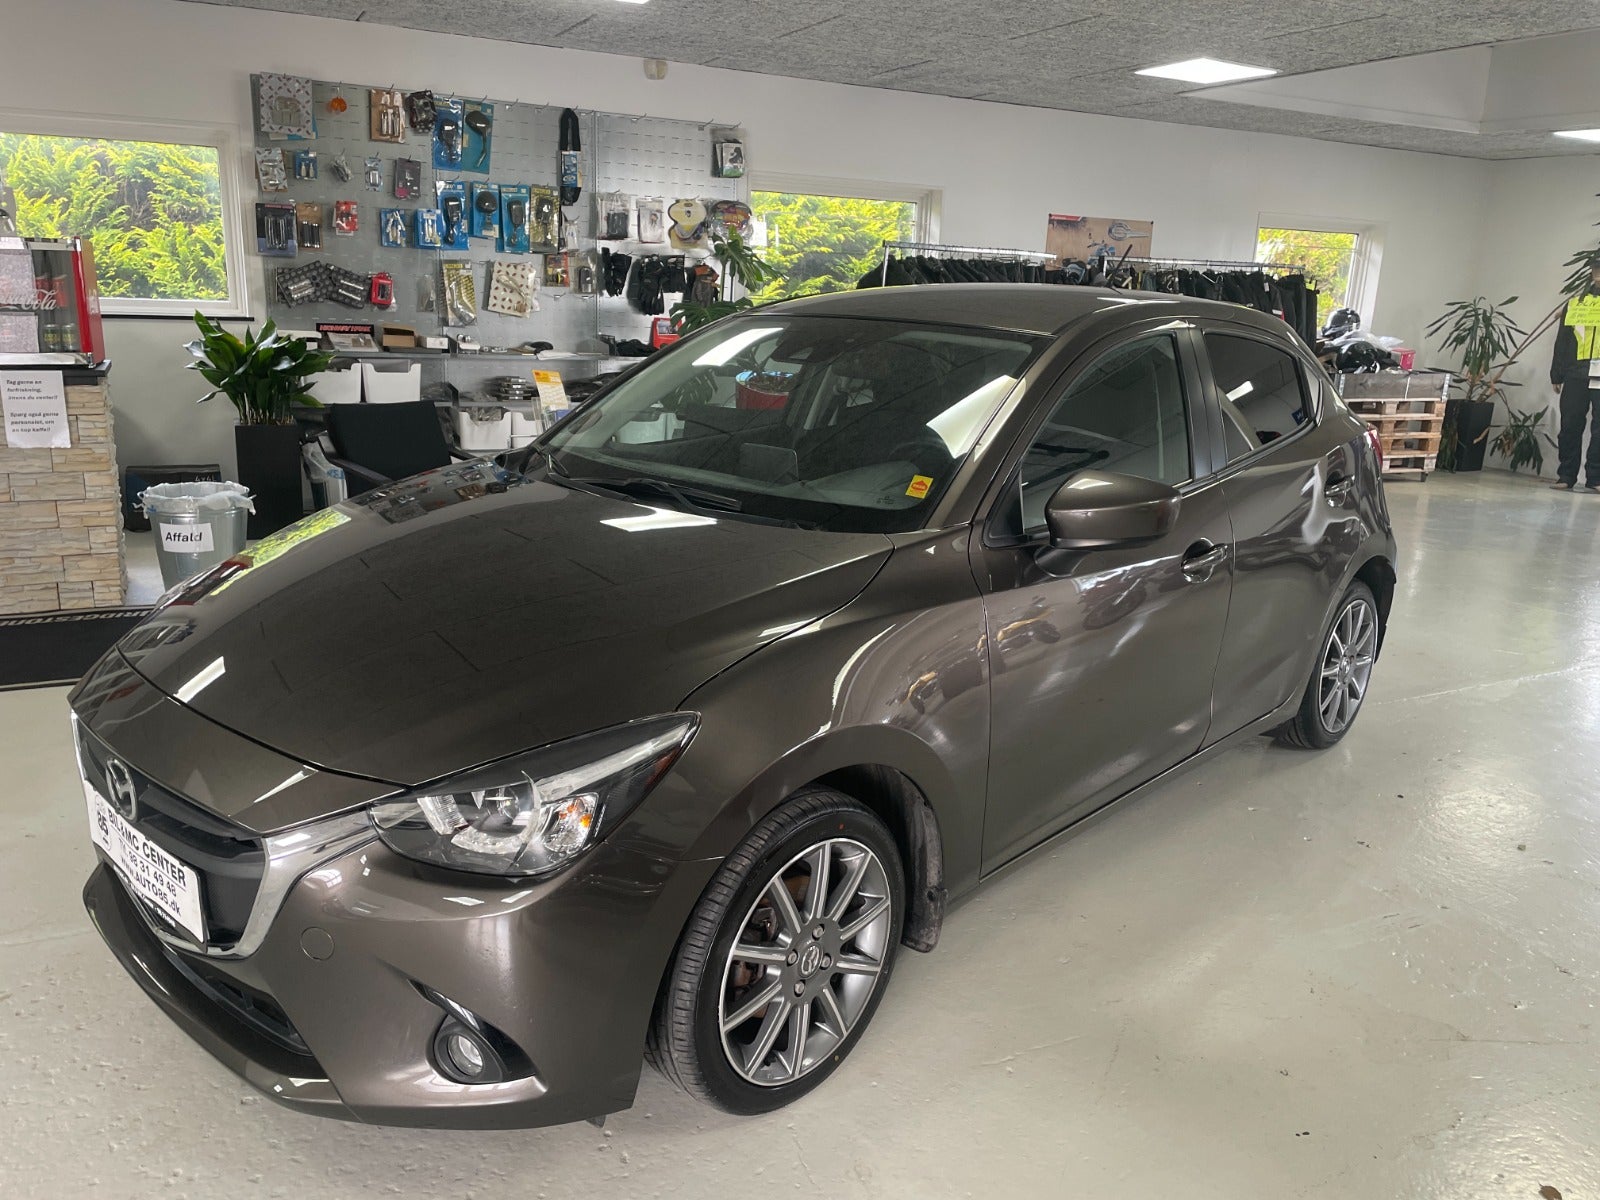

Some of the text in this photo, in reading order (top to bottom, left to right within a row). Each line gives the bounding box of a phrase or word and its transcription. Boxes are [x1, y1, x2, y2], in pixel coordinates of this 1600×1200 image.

[166, 532, 202, 542] Affald
[0, 610, 150, 626] RIDGESTON
[139, 860, 150, 877] 31
[153, 870, 164, 886] 49
[142, 842, 186, 887] CENTER
